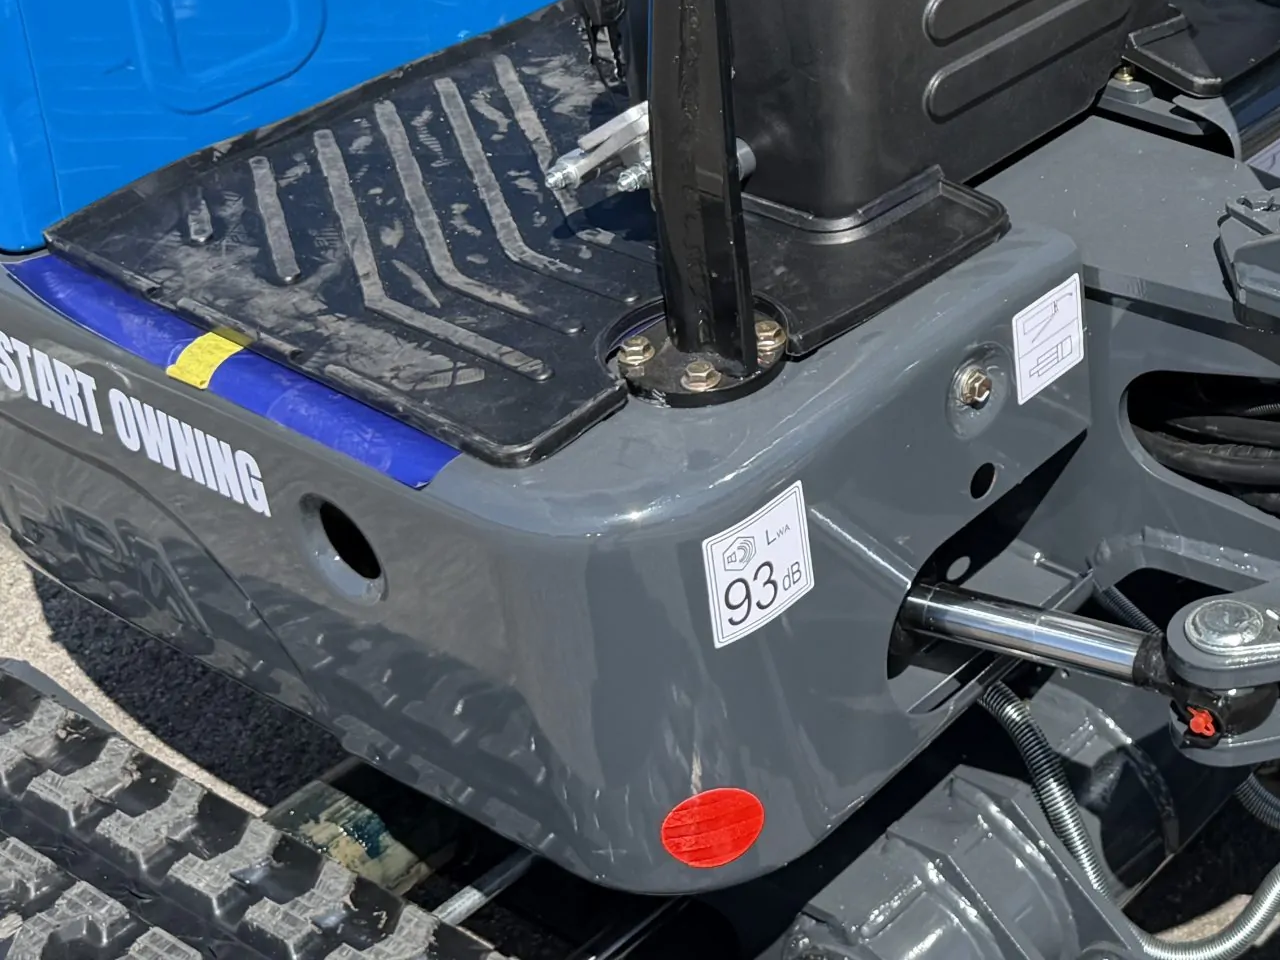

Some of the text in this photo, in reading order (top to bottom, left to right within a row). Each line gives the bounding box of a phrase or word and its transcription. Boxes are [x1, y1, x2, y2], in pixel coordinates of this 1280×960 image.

[0, 330, 272, 518] START OWNING
[724, 560, 802, 626] 93 dB
